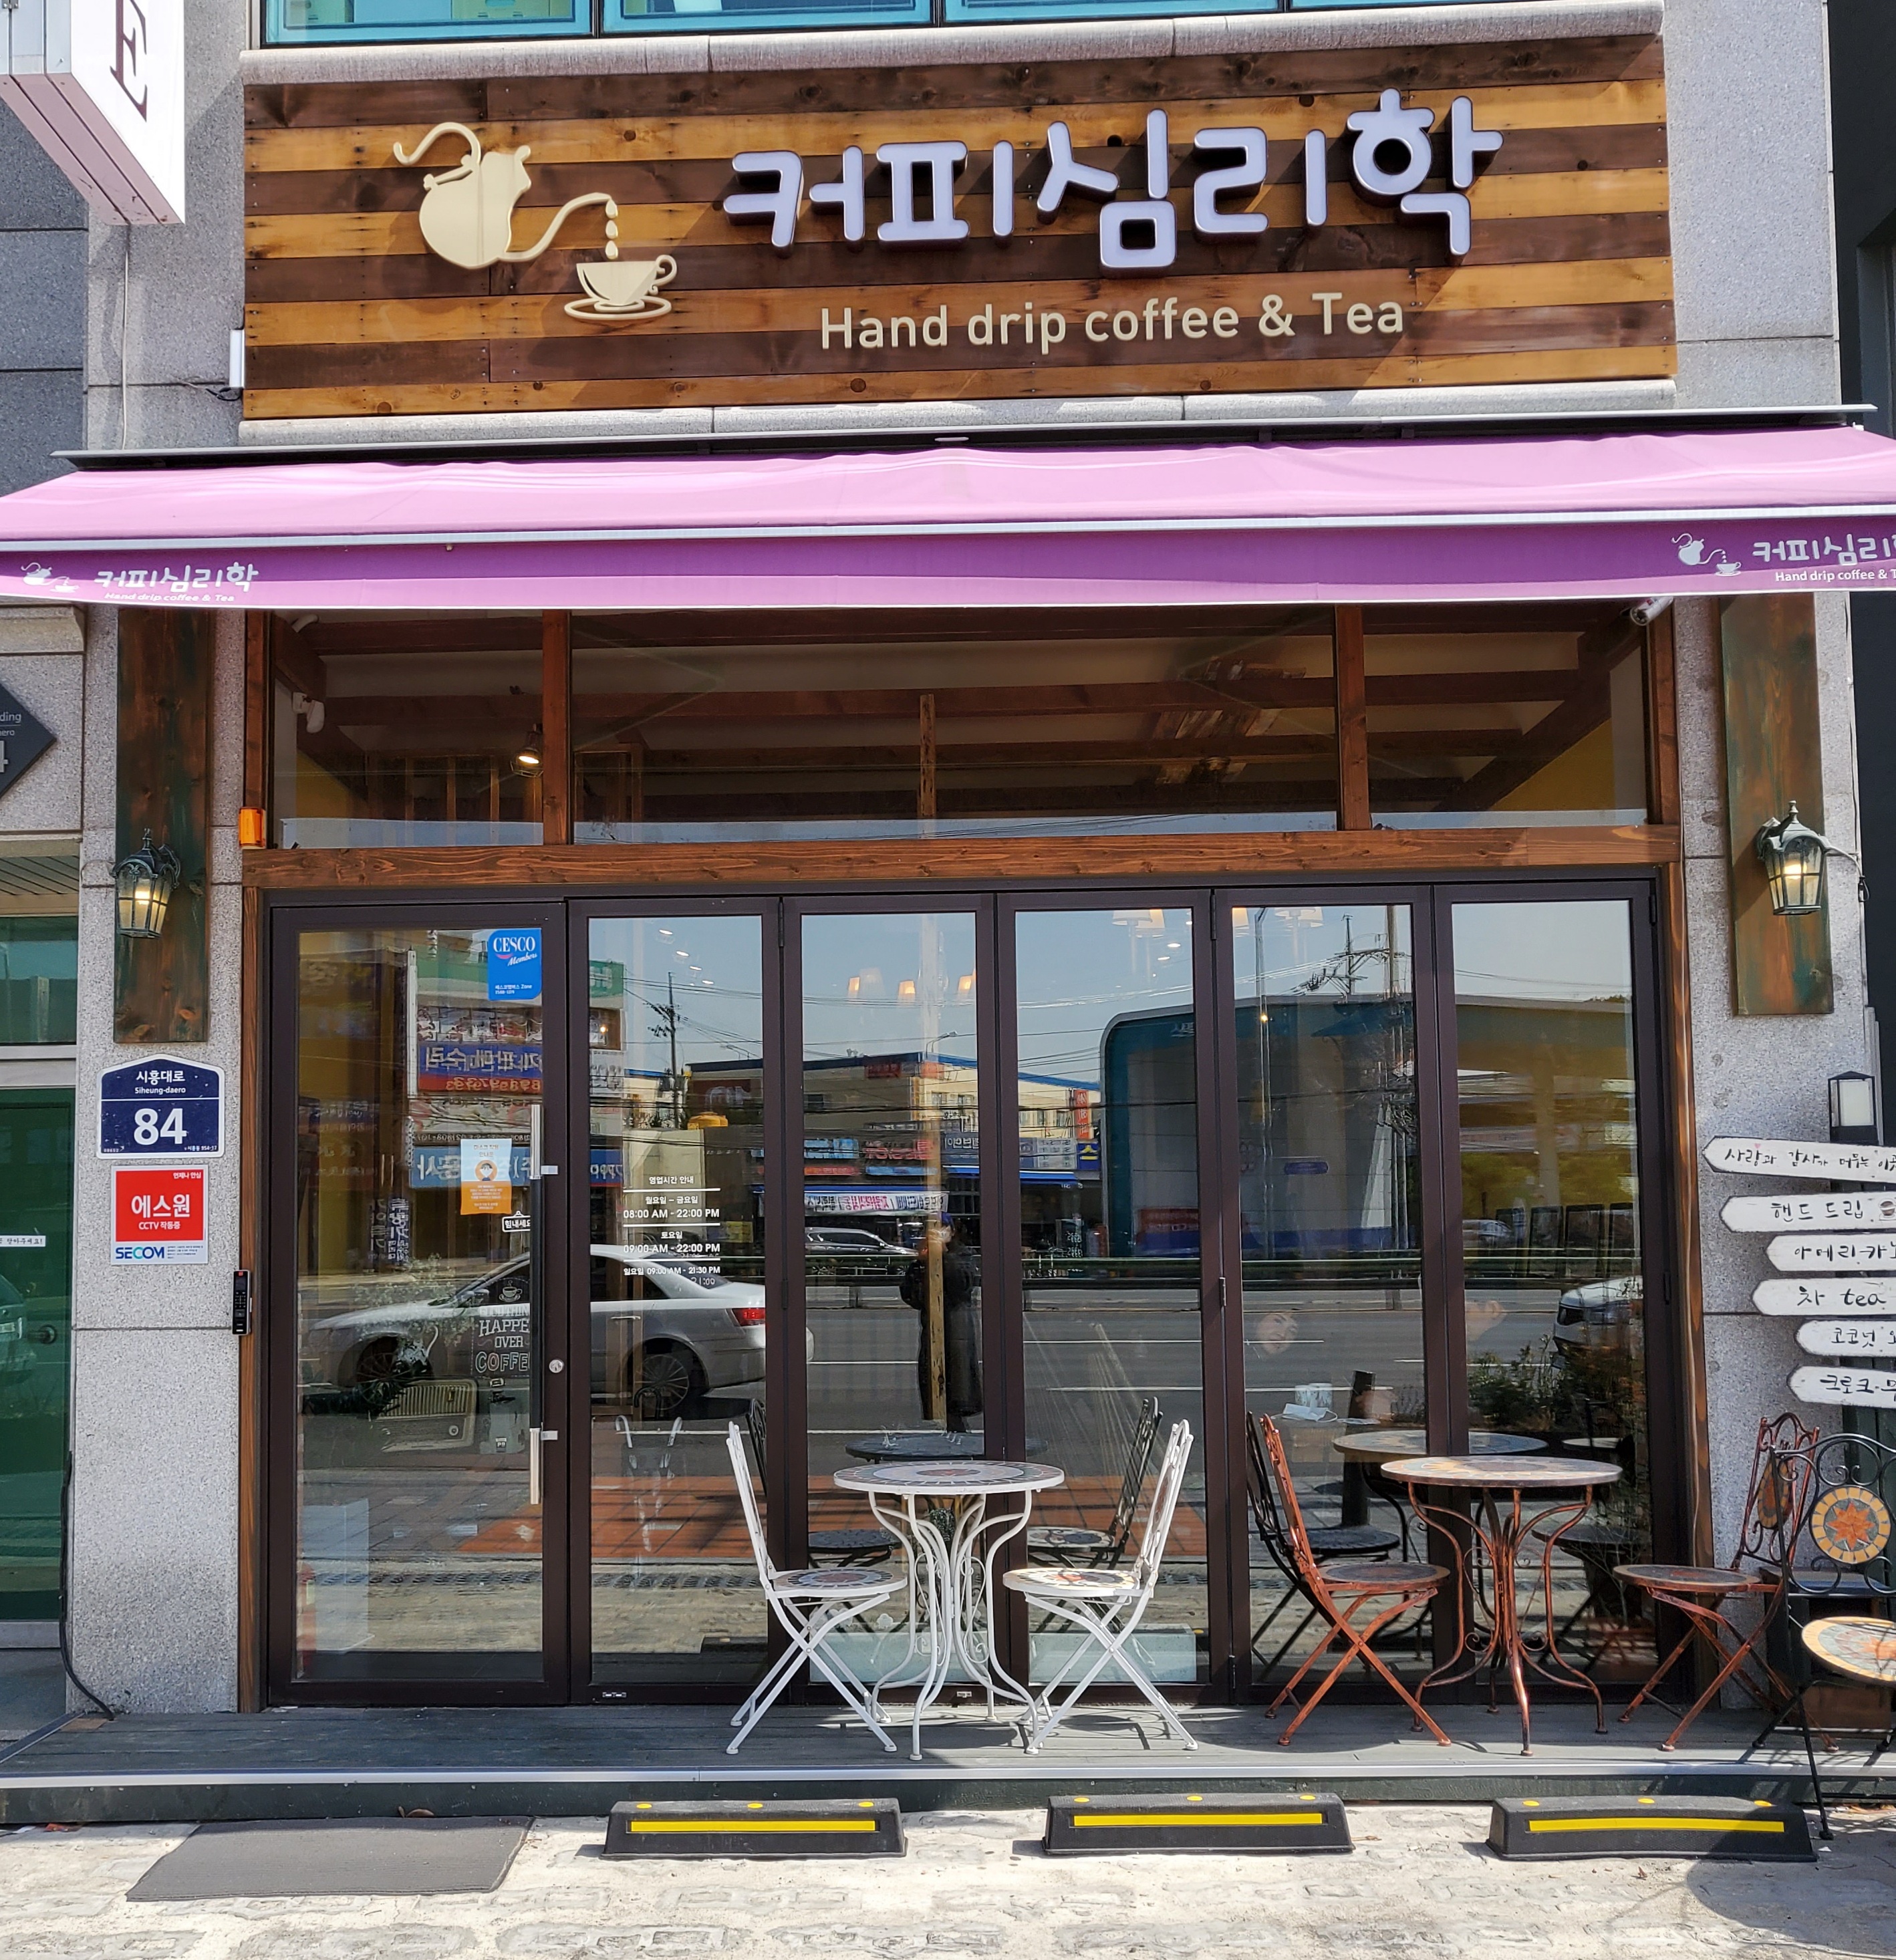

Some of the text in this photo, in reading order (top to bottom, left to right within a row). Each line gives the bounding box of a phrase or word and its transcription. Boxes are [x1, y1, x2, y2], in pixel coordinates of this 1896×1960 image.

[722, 87, 1504, 274] 커피심리학
[821, 291, 1405, 356] Hand drip coffee & Tea
[94, 561, 259, 593] 커피심리학
[1775, 571, 1807, 582] Hand
[1810, 570, 1835, 583] drip
[1838, 569, 1875, 580] coffee
[1879, 569, 1888, 579] &
[104, 592, 136, 600] Hand
[138, 593, 162, 602] drip
[163, 593, 199, 601] coffee
[215, 594, 235, 602] Tea
[493, 936, 535, 952] CESCO
[507, 952, 537, 966] Members
[136, 1070, 186, 1085] 시흥대로
[134, 1087, 186, 1095] Siheung-daero
[134, 1108, 188, 1145] 84
[1724, 1148, 1778, 1167] 사랑과
[1839, 1153, 1870, 1169] 머무는
[649, 1175, 694, 1185] 영업시간 안내
[131, 1194, 190, 1218] 에스원
[646, 1196, 667, 1204] 월요일
[676, 1196, 698, 1204] 금요일
[623, 1210, 649, 1218] 08:00
[652, 1210, 668, 1218] AM
[676, 1209, 702, 1218] 22:00
[705, 1208, 720, 1218] PM
[1771, 1200, 1863, 1222] 핸드 드립
[138, 1221, 181, 1230] CCTV 작동중
[661, 1231, 683, 1239] 토요일
[116, 1246, 164, 1259] SECOM
[624, 1244, 648, 1253] 09:00
[651, 1244, 668, 1253] AM
[676, 1244, 702, 1252] 22:00
[705, 1243, 720, 1252] PM
[624, 1268, 644, 1276] 일요일
[1797, 1286, 1887, 1306] 차 tea
[495, 1336, 524, 1348] OVER
[1831, 1328, 1875, 1349] 코코넛
[475, 1351, 530, 1373] COFFE
